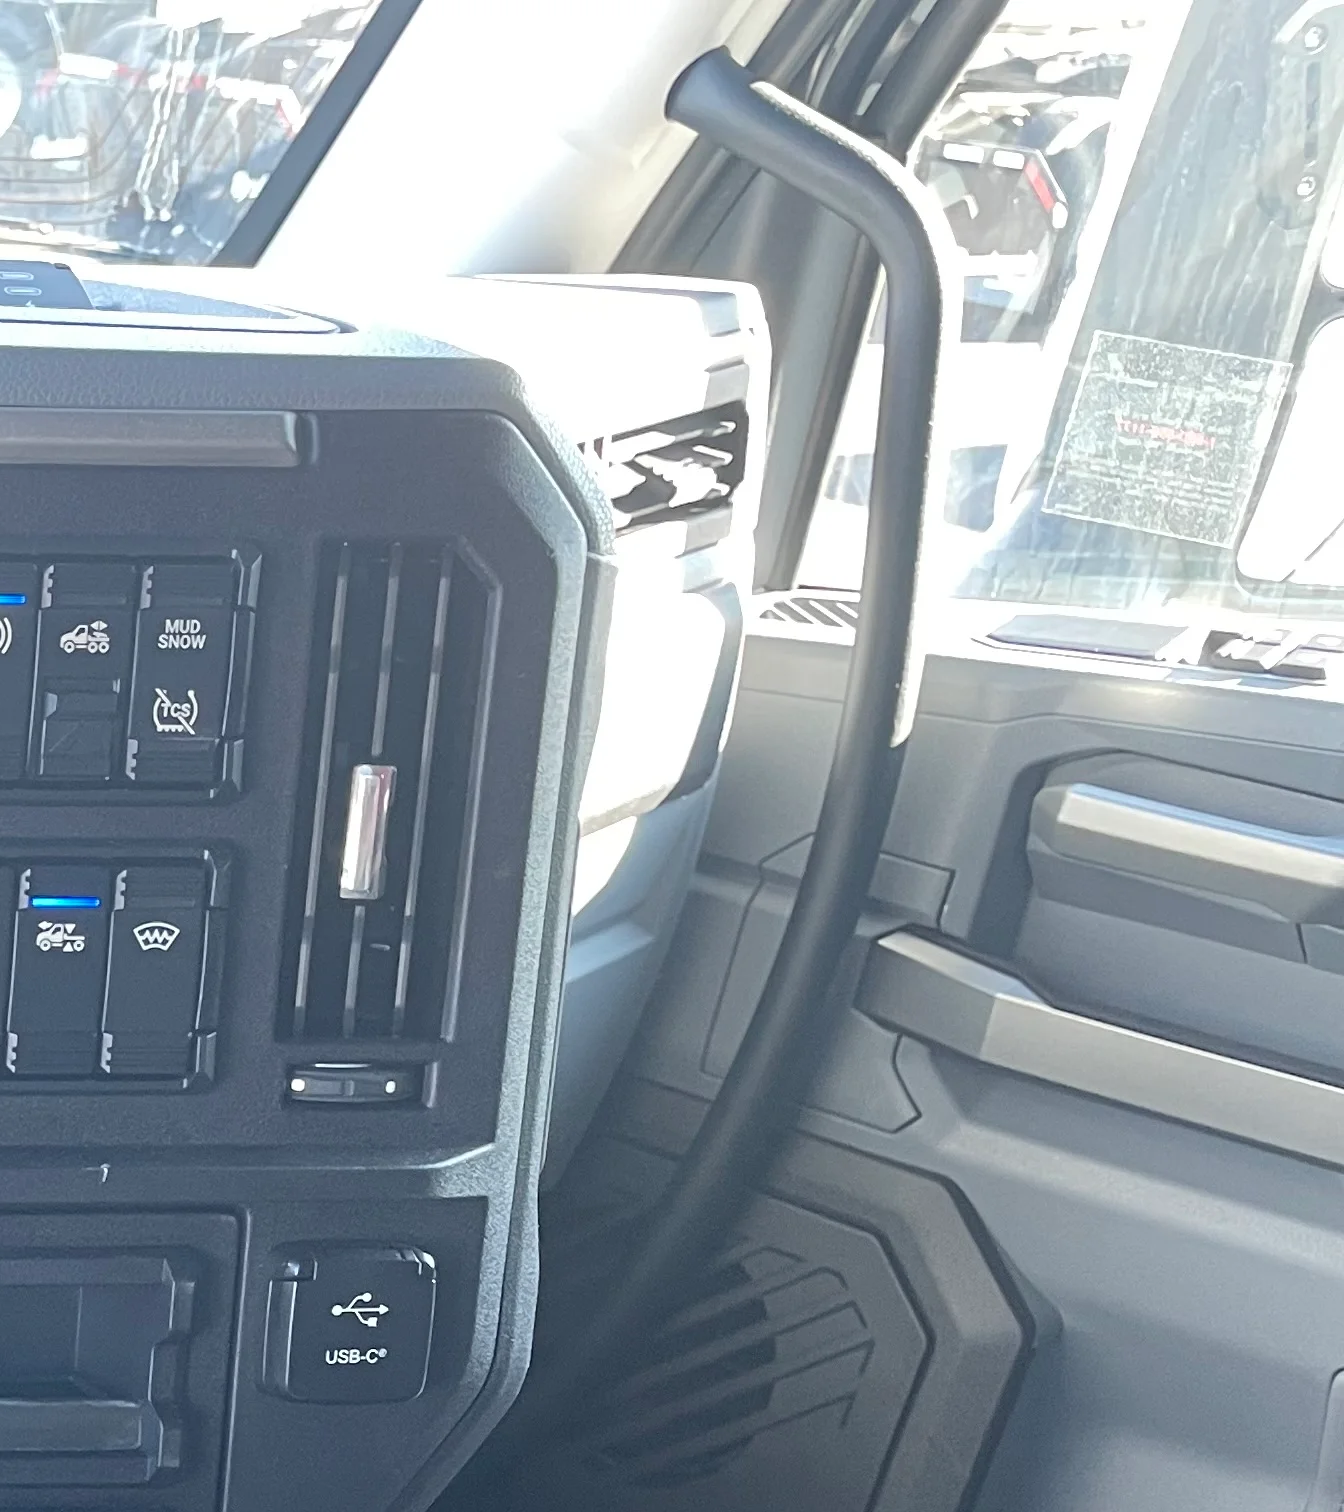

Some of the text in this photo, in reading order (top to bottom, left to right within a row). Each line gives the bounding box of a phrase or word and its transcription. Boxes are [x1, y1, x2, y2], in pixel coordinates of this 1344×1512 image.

[165, 619, 201, 634] MUD
[157, 634, 206, 649] SNOW
[161, 703, 191, 718] TCS
